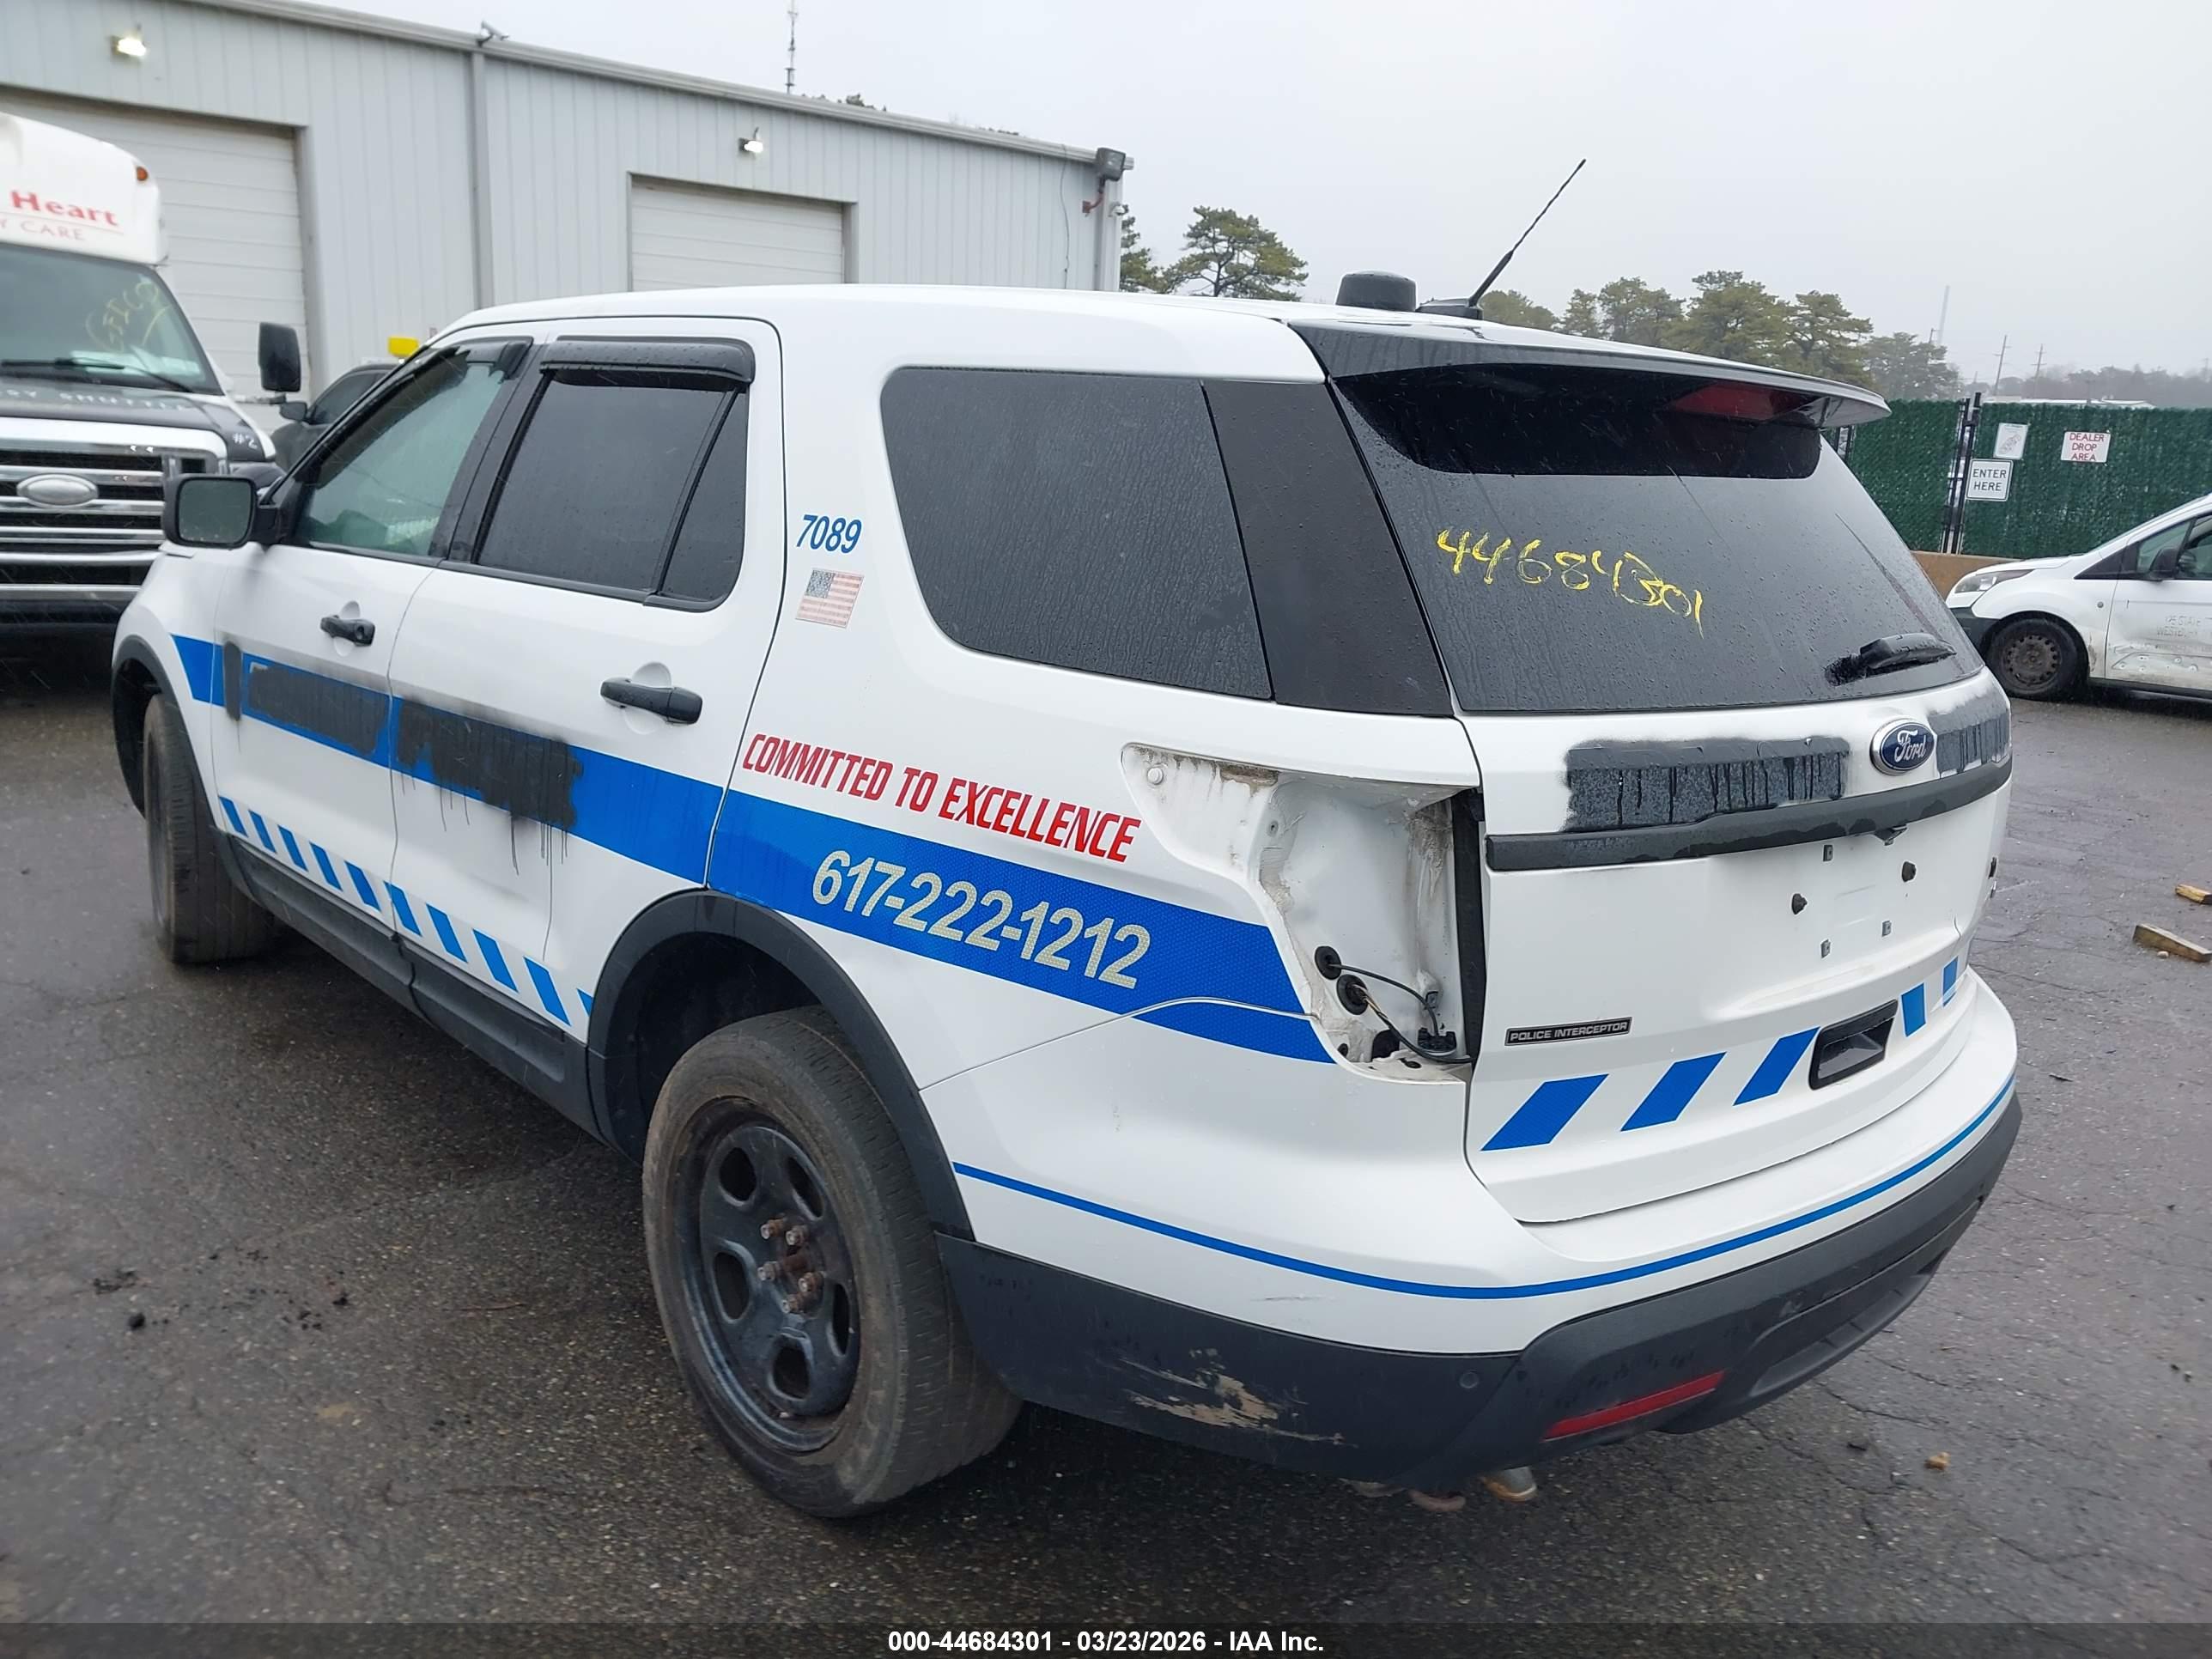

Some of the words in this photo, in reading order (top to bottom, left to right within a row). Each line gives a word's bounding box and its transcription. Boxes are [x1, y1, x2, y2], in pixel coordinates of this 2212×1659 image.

[10, 190, 118, 227] Heart
[20, 220, 86, 241] CARE
[2069, 433, 2105, 442] DEALER
[2072, 442, 2097, 451] DROP
[2071, 453, 2096, 461] AREA
[1972, 468, 2007, 478] ENTER
[1973, 482, 2002, 491] HERE
[796, 514, 863, 554] 7089
[1894, 729, 1927, 763] Ford
[742, 732, 894, 801] COMMITTED
[895, 767, 939, 813] TO
[939, 776, 1142, 864] EXCELLENCE
[811, 849, 1152, 990] 617-222-1212
[1510, 1030, 1552, 1042] POLICE
[1554, 1021, 1628, 1038] INTERCEPTOR
